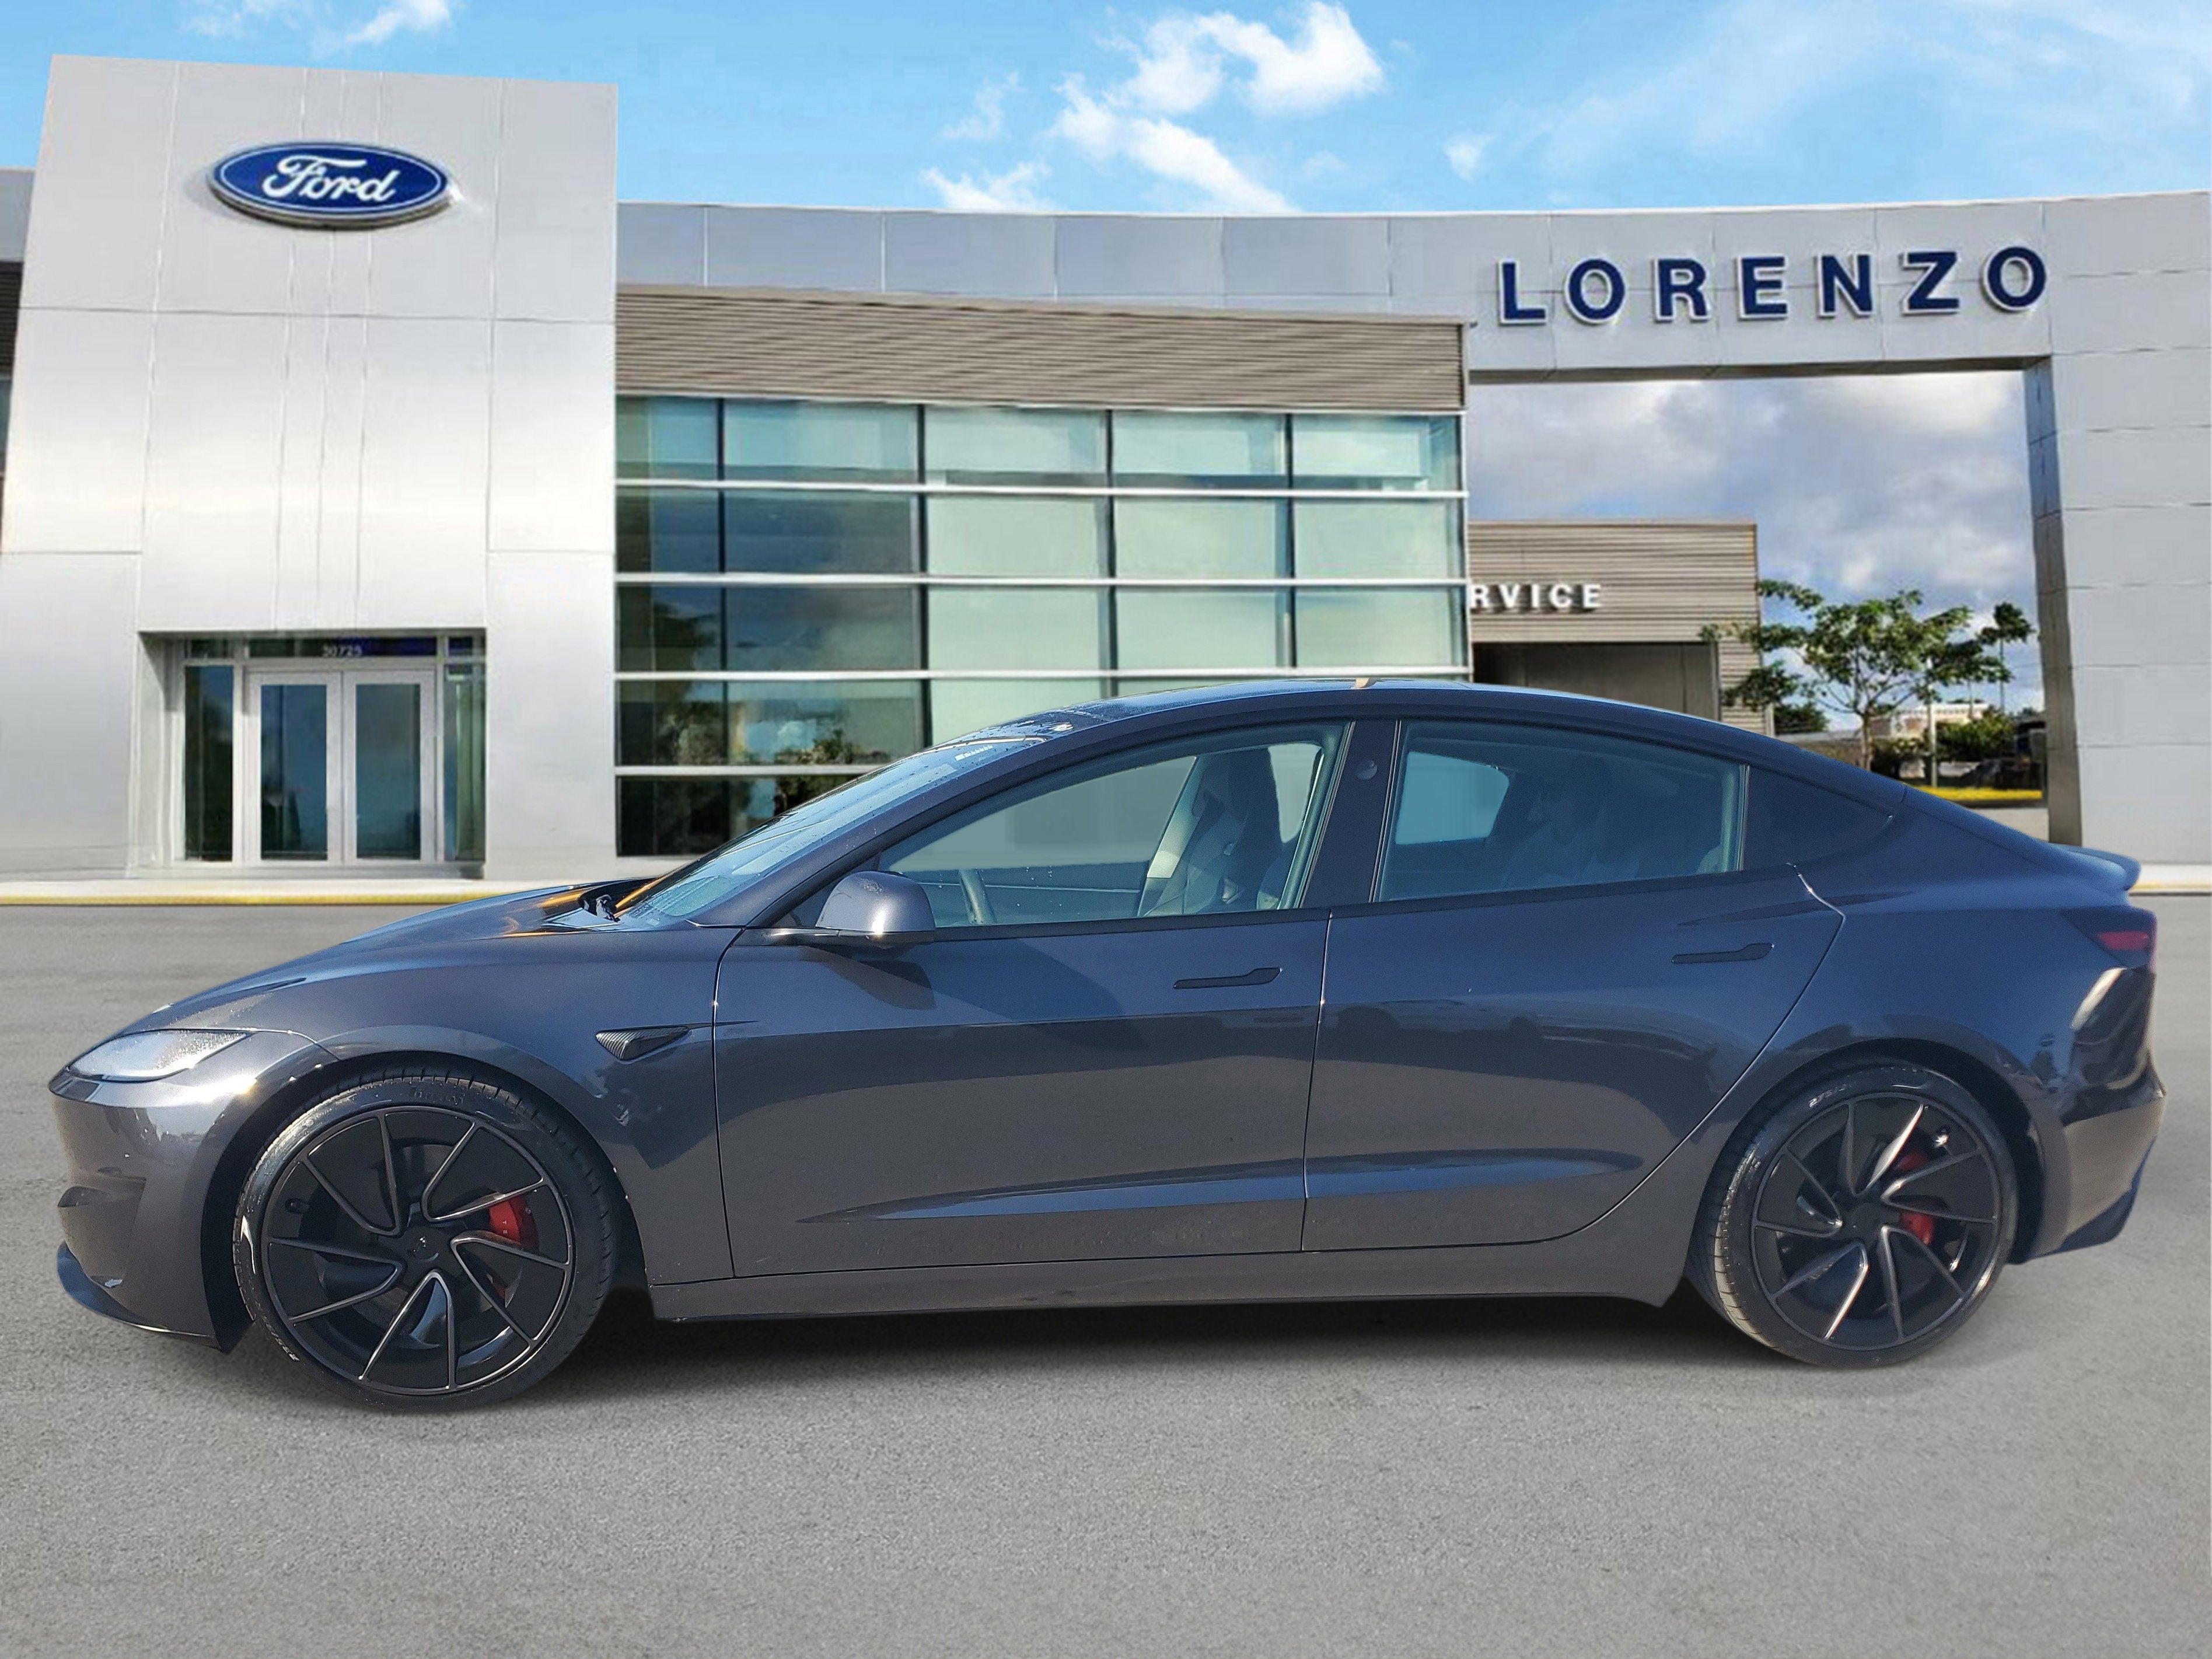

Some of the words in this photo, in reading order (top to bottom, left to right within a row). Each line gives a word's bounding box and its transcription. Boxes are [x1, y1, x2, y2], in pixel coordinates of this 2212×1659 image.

[262, 154, 401, 202] Ford
[1498, 246, 2047, 325] LORENZO
[1470, 584, 1601, 609] RVICE
